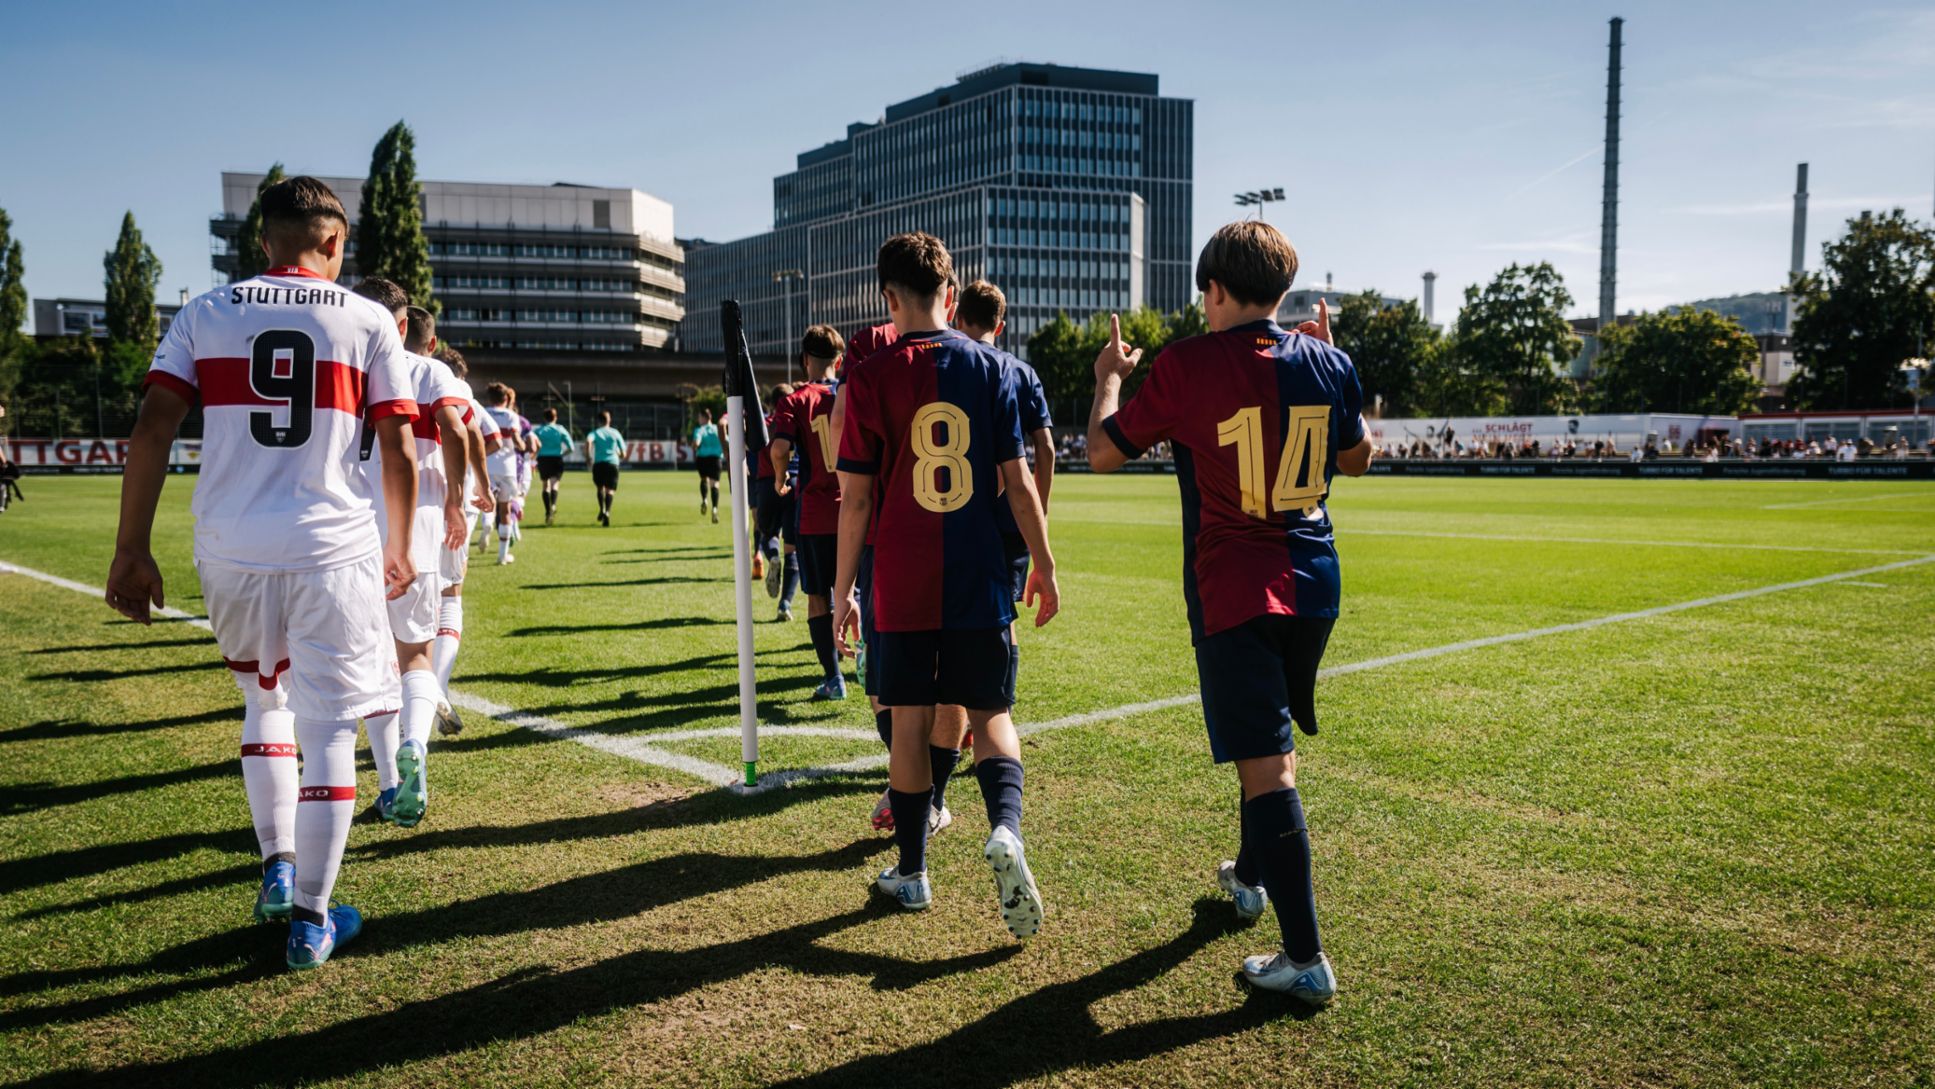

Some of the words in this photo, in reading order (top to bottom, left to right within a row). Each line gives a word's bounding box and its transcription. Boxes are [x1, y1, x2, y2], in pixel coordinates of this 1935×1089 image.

[231, 286, 348, 308] STUTTGART
[249, 327, 316, 449] 9
[1485, 422, 1533, 433] SCHLÄGT
[911, 401, 974, 513] 8
[1217, 404, 1332, 520] 14
